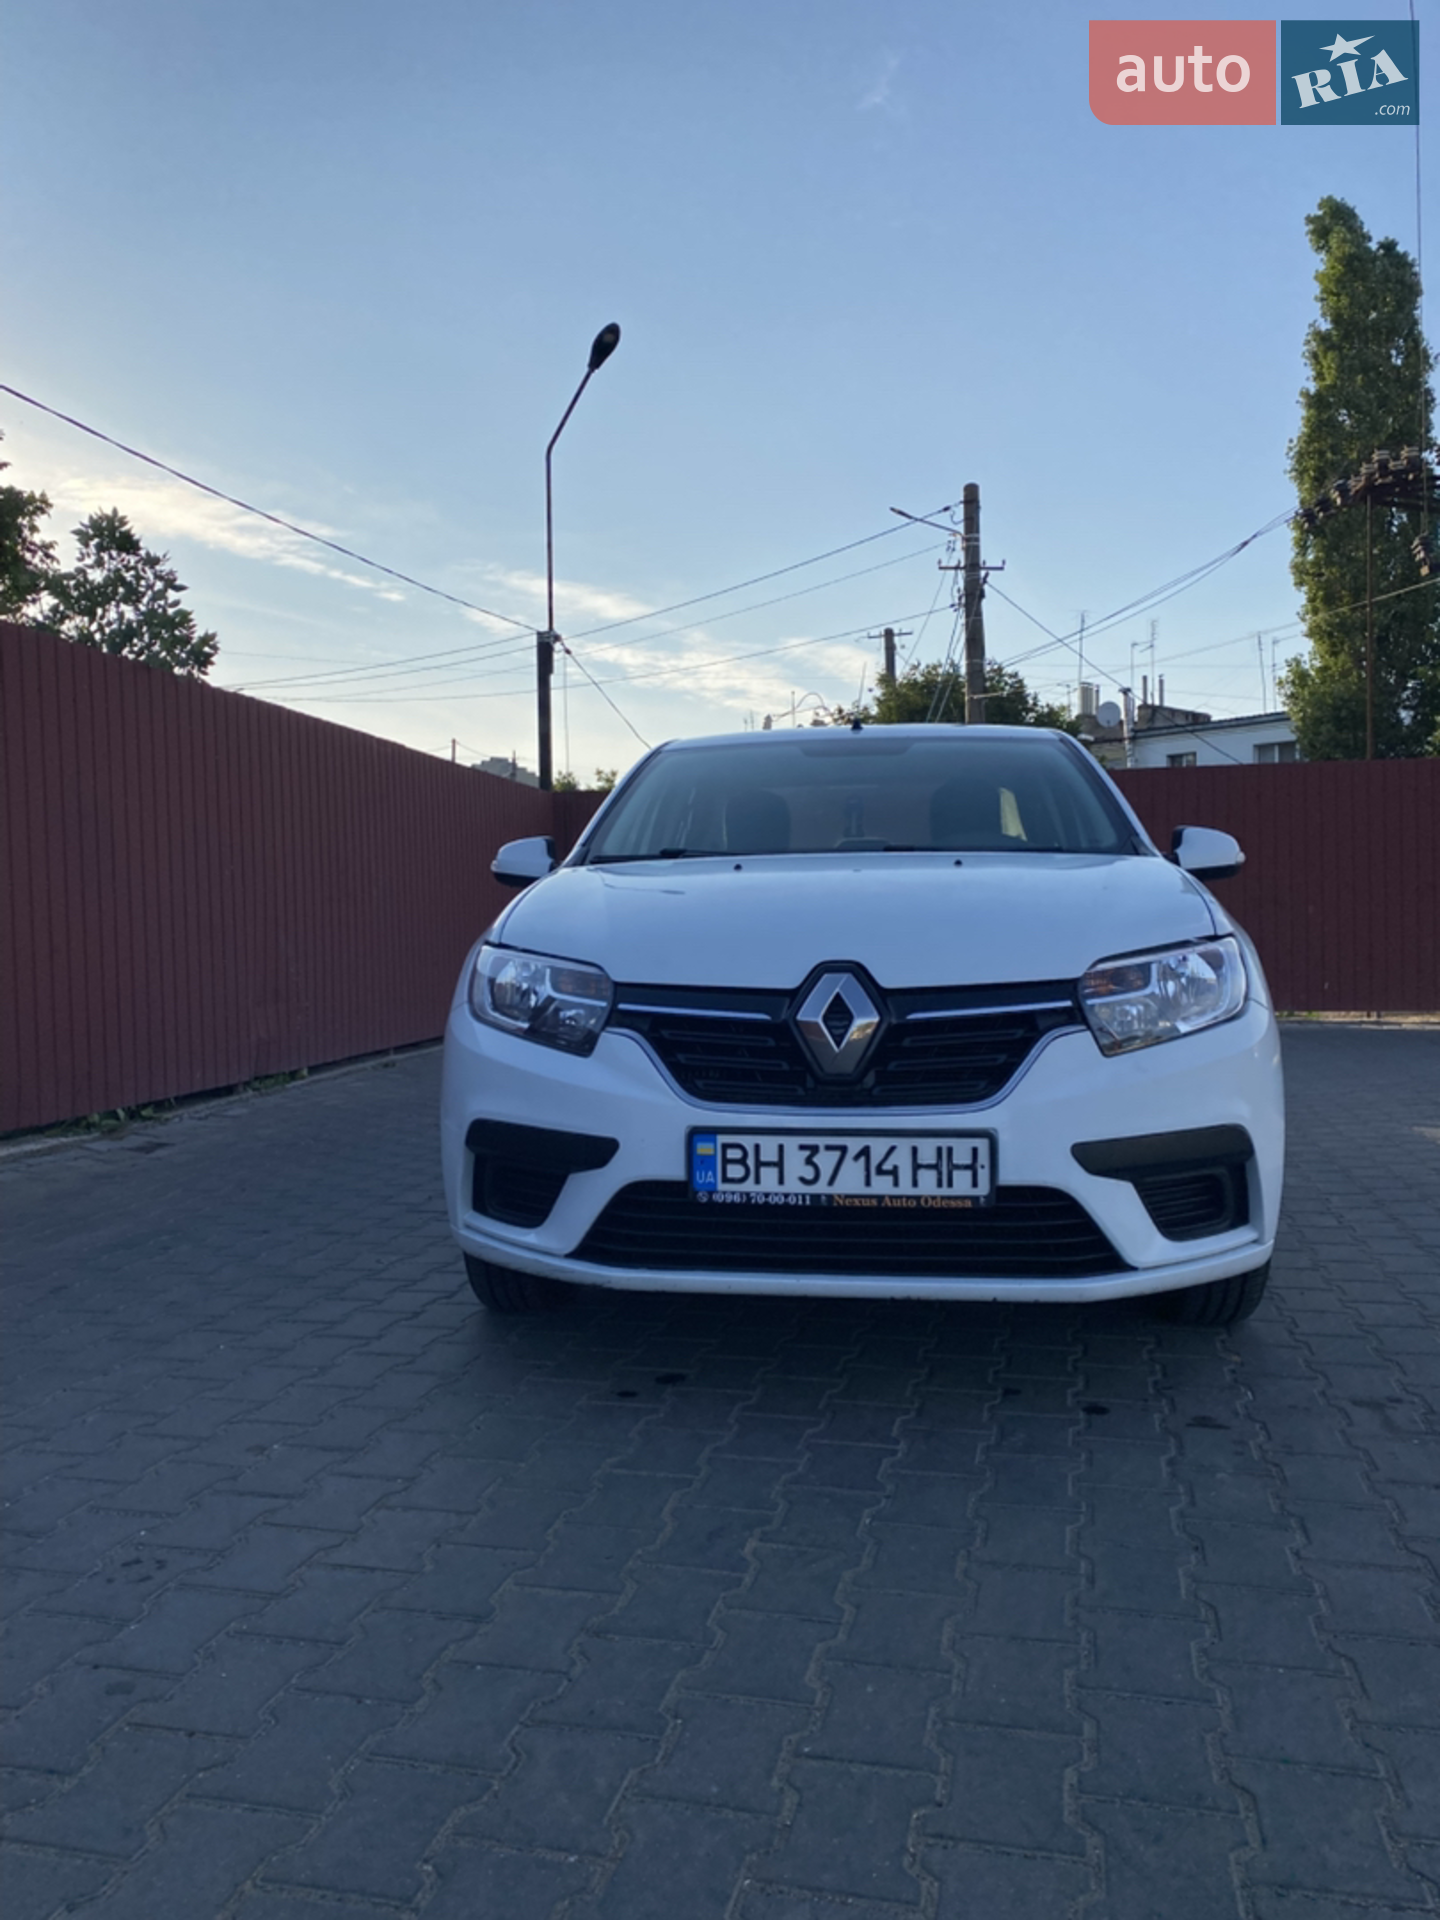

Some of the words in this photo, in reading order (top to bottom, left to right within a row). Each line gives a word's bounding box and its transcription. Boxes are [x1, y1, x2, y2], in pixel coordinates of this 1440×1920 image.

[720, 1142, 785, 1186] BH
[797, 1144, 900, 1188] 3714
[911, 1145, 979, 1189] HH
[696, 1171, 715, 1184] UA
[832, 1194, 878, 1207] Nexus
[881, 1195, 917, 1207] Auto
[920, 1195, 973, 1208] Odessa
